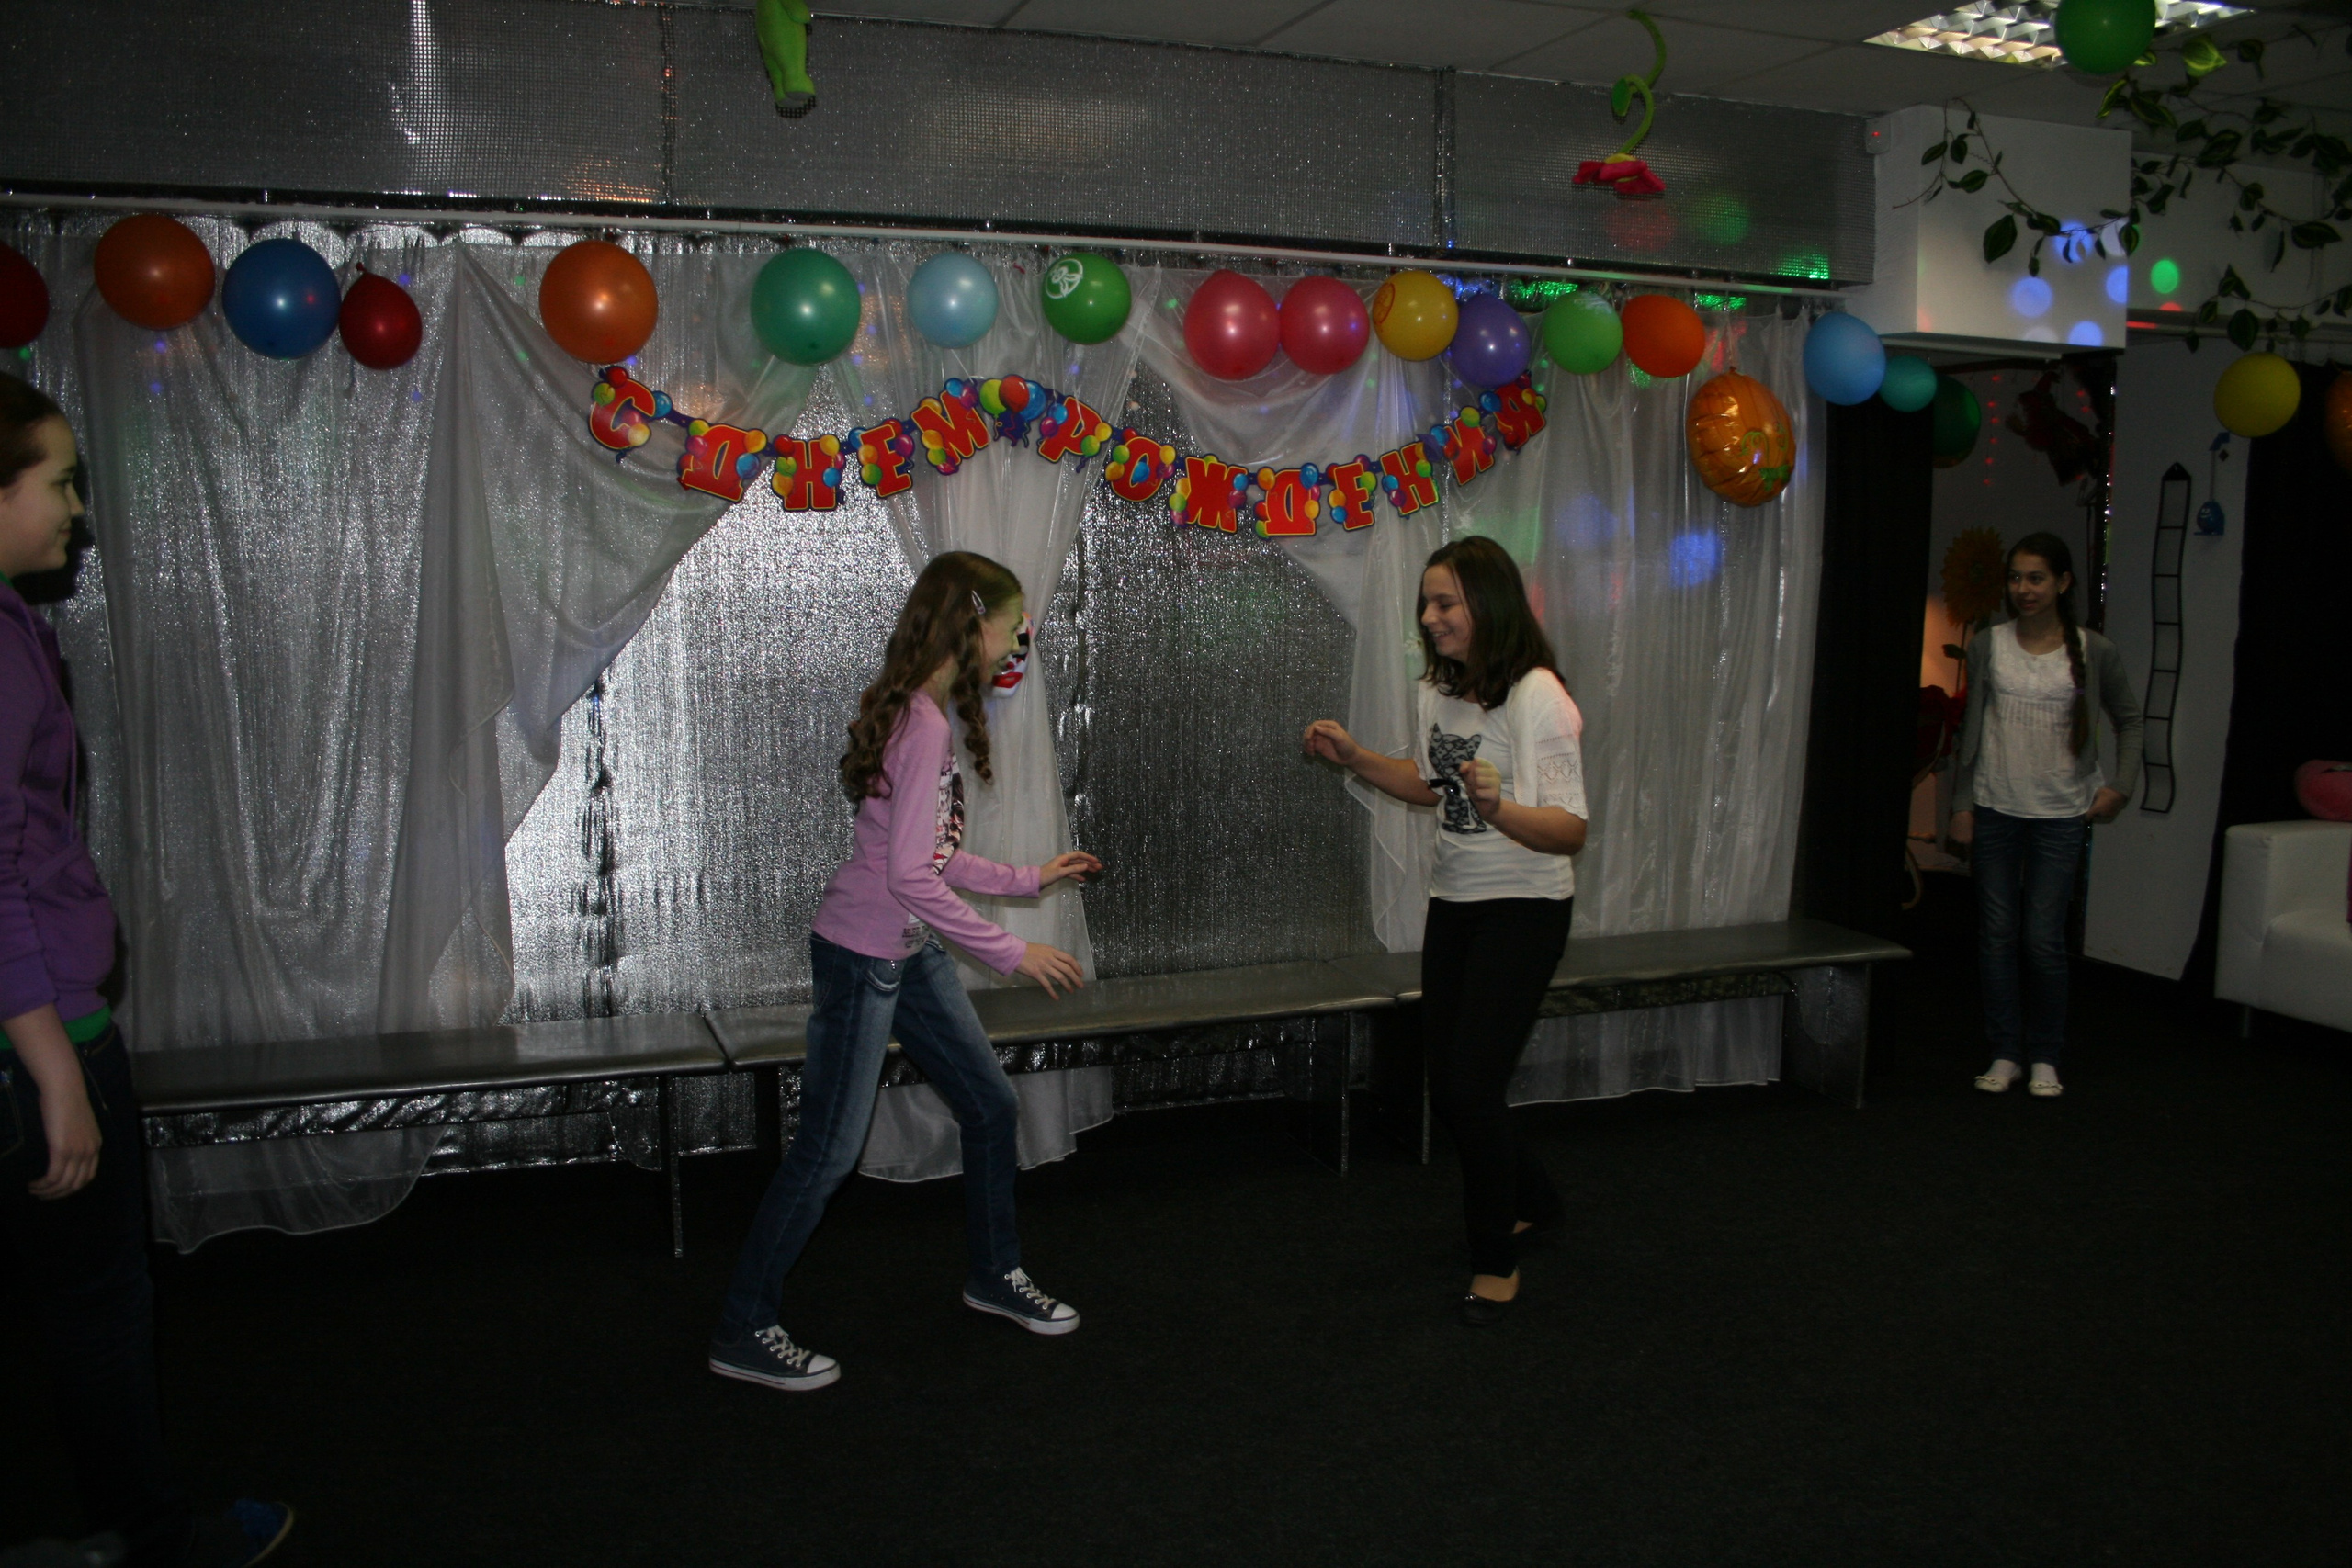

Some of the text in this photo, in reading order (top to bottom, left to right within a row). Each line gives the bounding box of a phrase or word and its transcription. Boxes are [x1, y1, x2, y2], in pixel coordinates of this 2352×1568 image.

[589, 369, 1547, 536] С ДНЕМ РОЖДЕНИЯ
